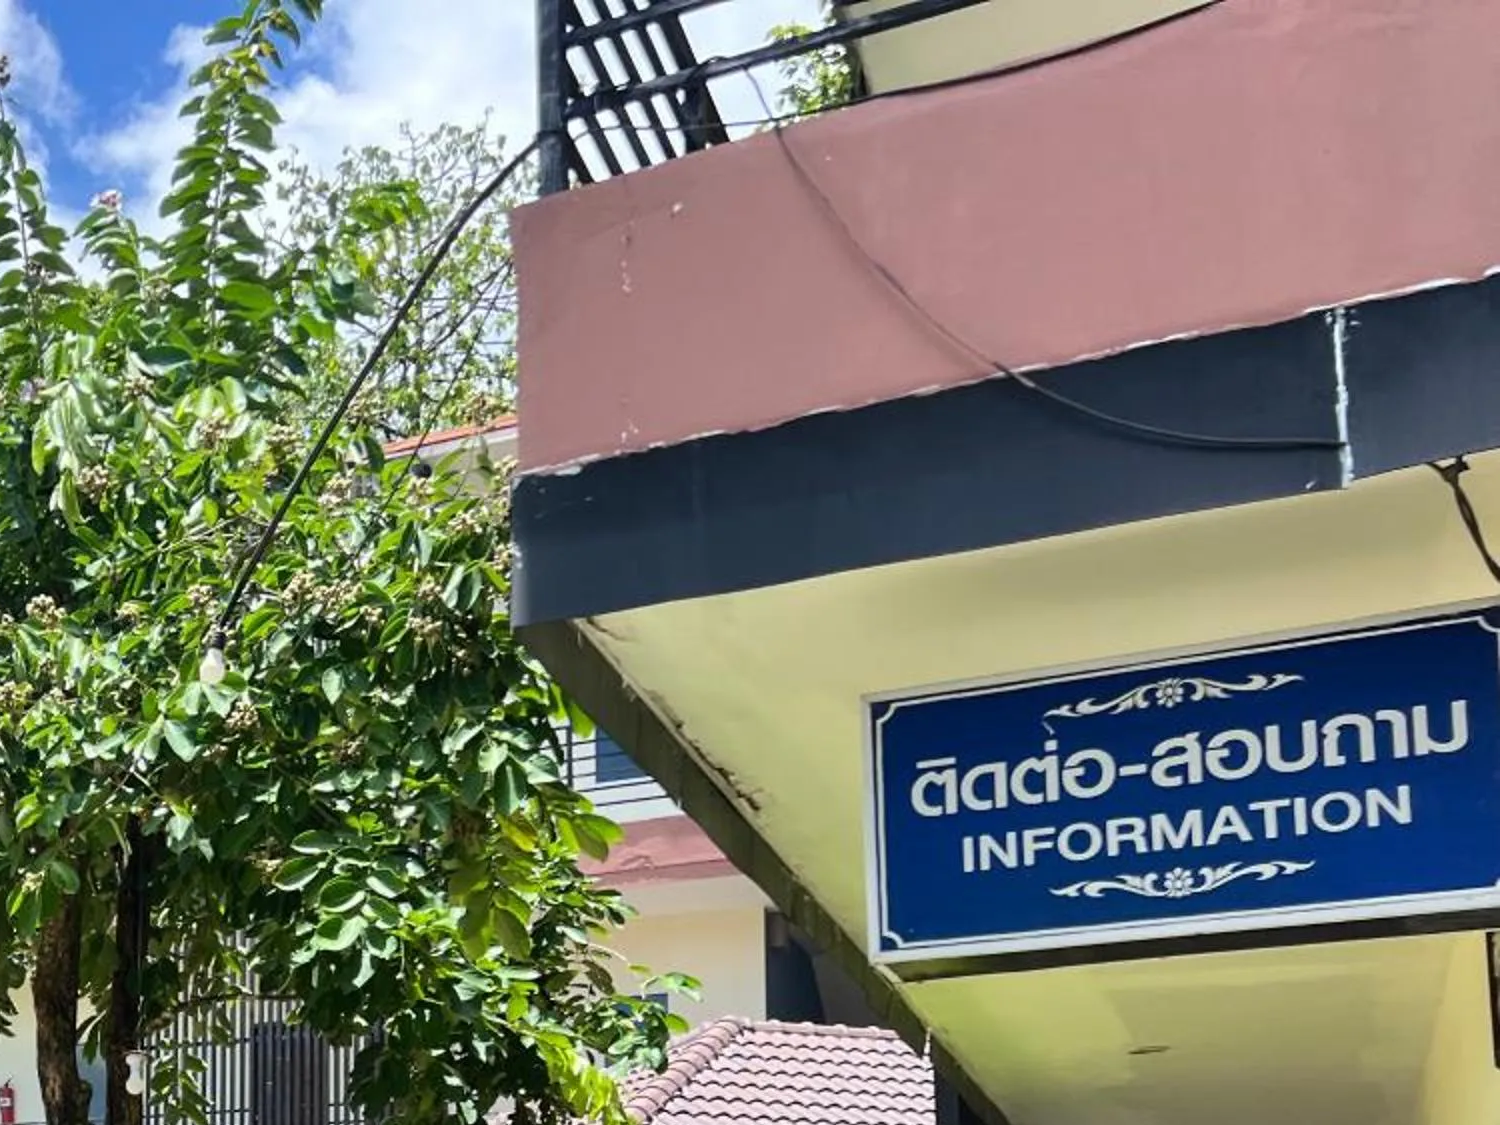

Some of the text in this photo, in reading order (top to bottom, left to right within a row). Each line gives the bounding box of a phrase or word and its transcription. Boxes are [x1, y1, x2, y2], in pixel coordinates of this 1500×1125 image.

[911, 699, 1470, 818] ติดต่อ-สอบถาม
[963, 785, 1413, 872] INFORMATION
